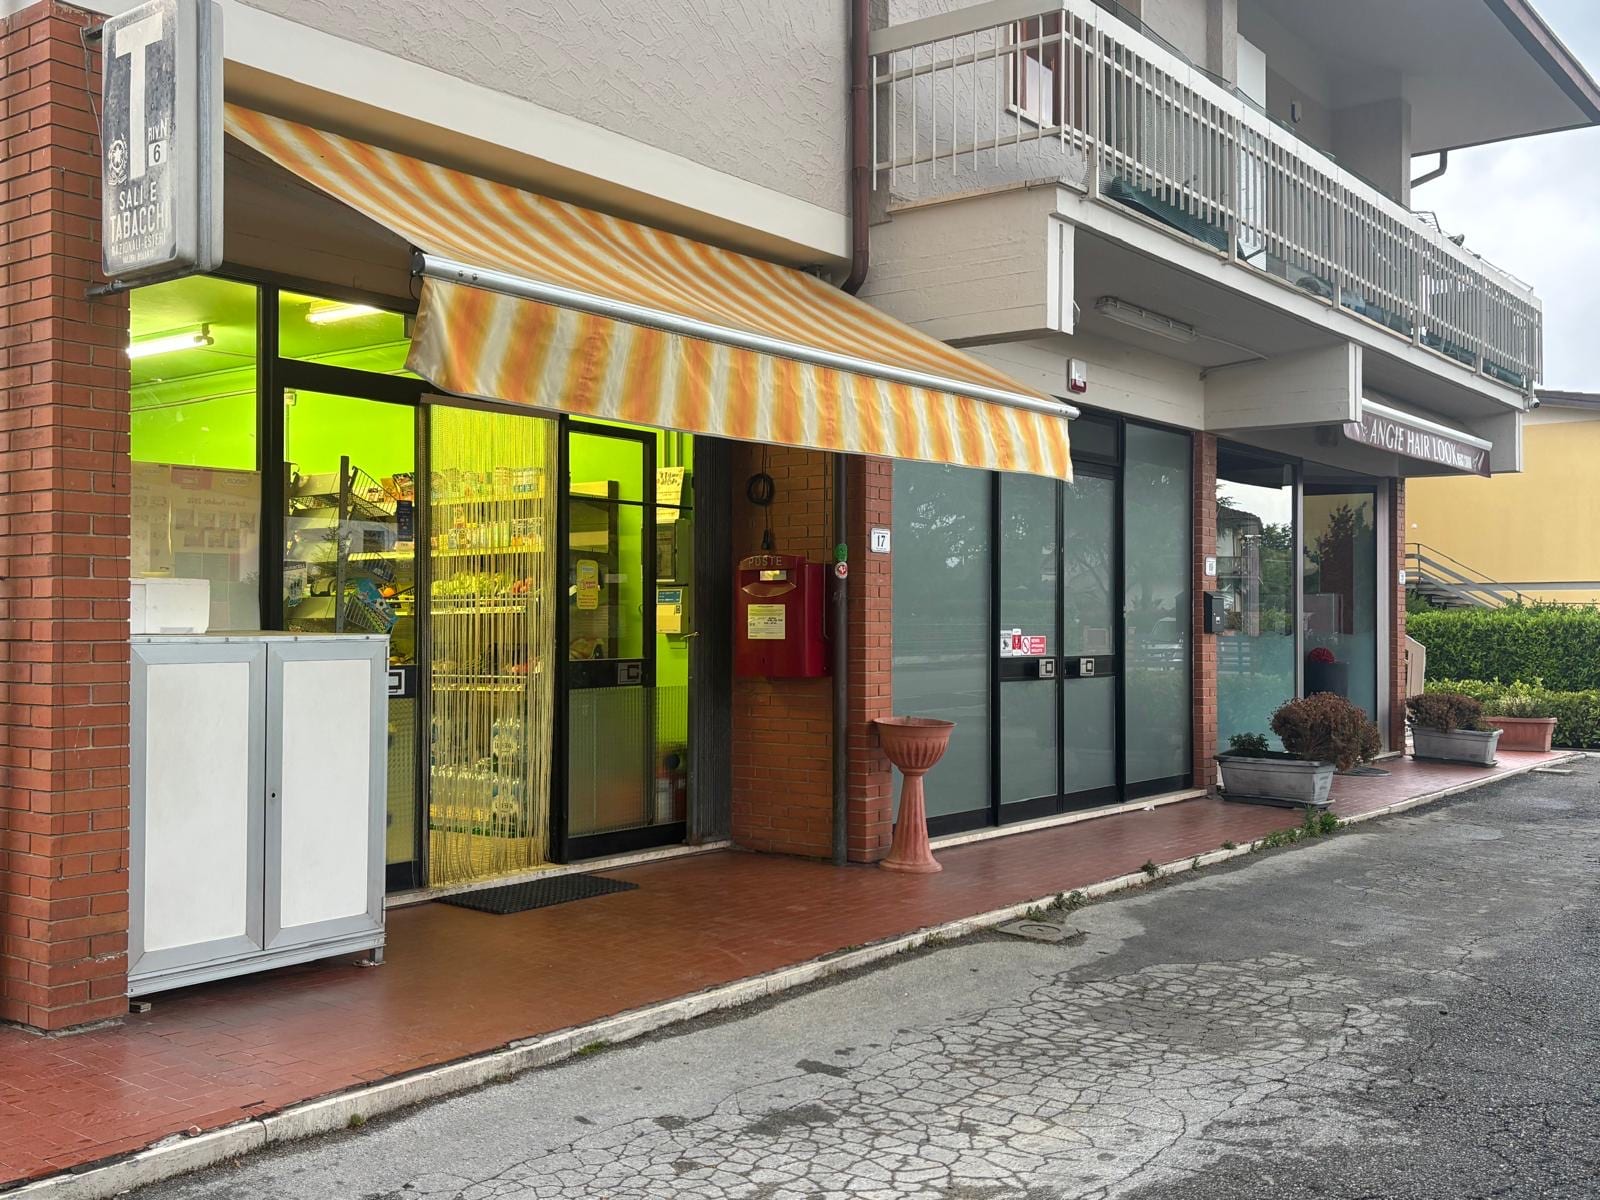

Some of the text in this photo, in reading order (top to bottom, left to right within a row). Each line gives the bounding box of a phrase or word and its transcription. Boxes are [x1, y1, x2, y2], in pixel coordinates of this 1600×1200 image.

[115, 12, 164, 181] T
[153, 143, 161, 163] 6
[119, 181, 157, 210] SALI E
[110, 200, 172, 242] TABACCHI
[1369, 419, 1404, 451] ANGIE
[1407, 430, 1430, 458] HAIR
[1432, 437, 1459, 465] LOOK
[877, 535, 886, 547] 17
[748, 555, 783, 567] POSTE
